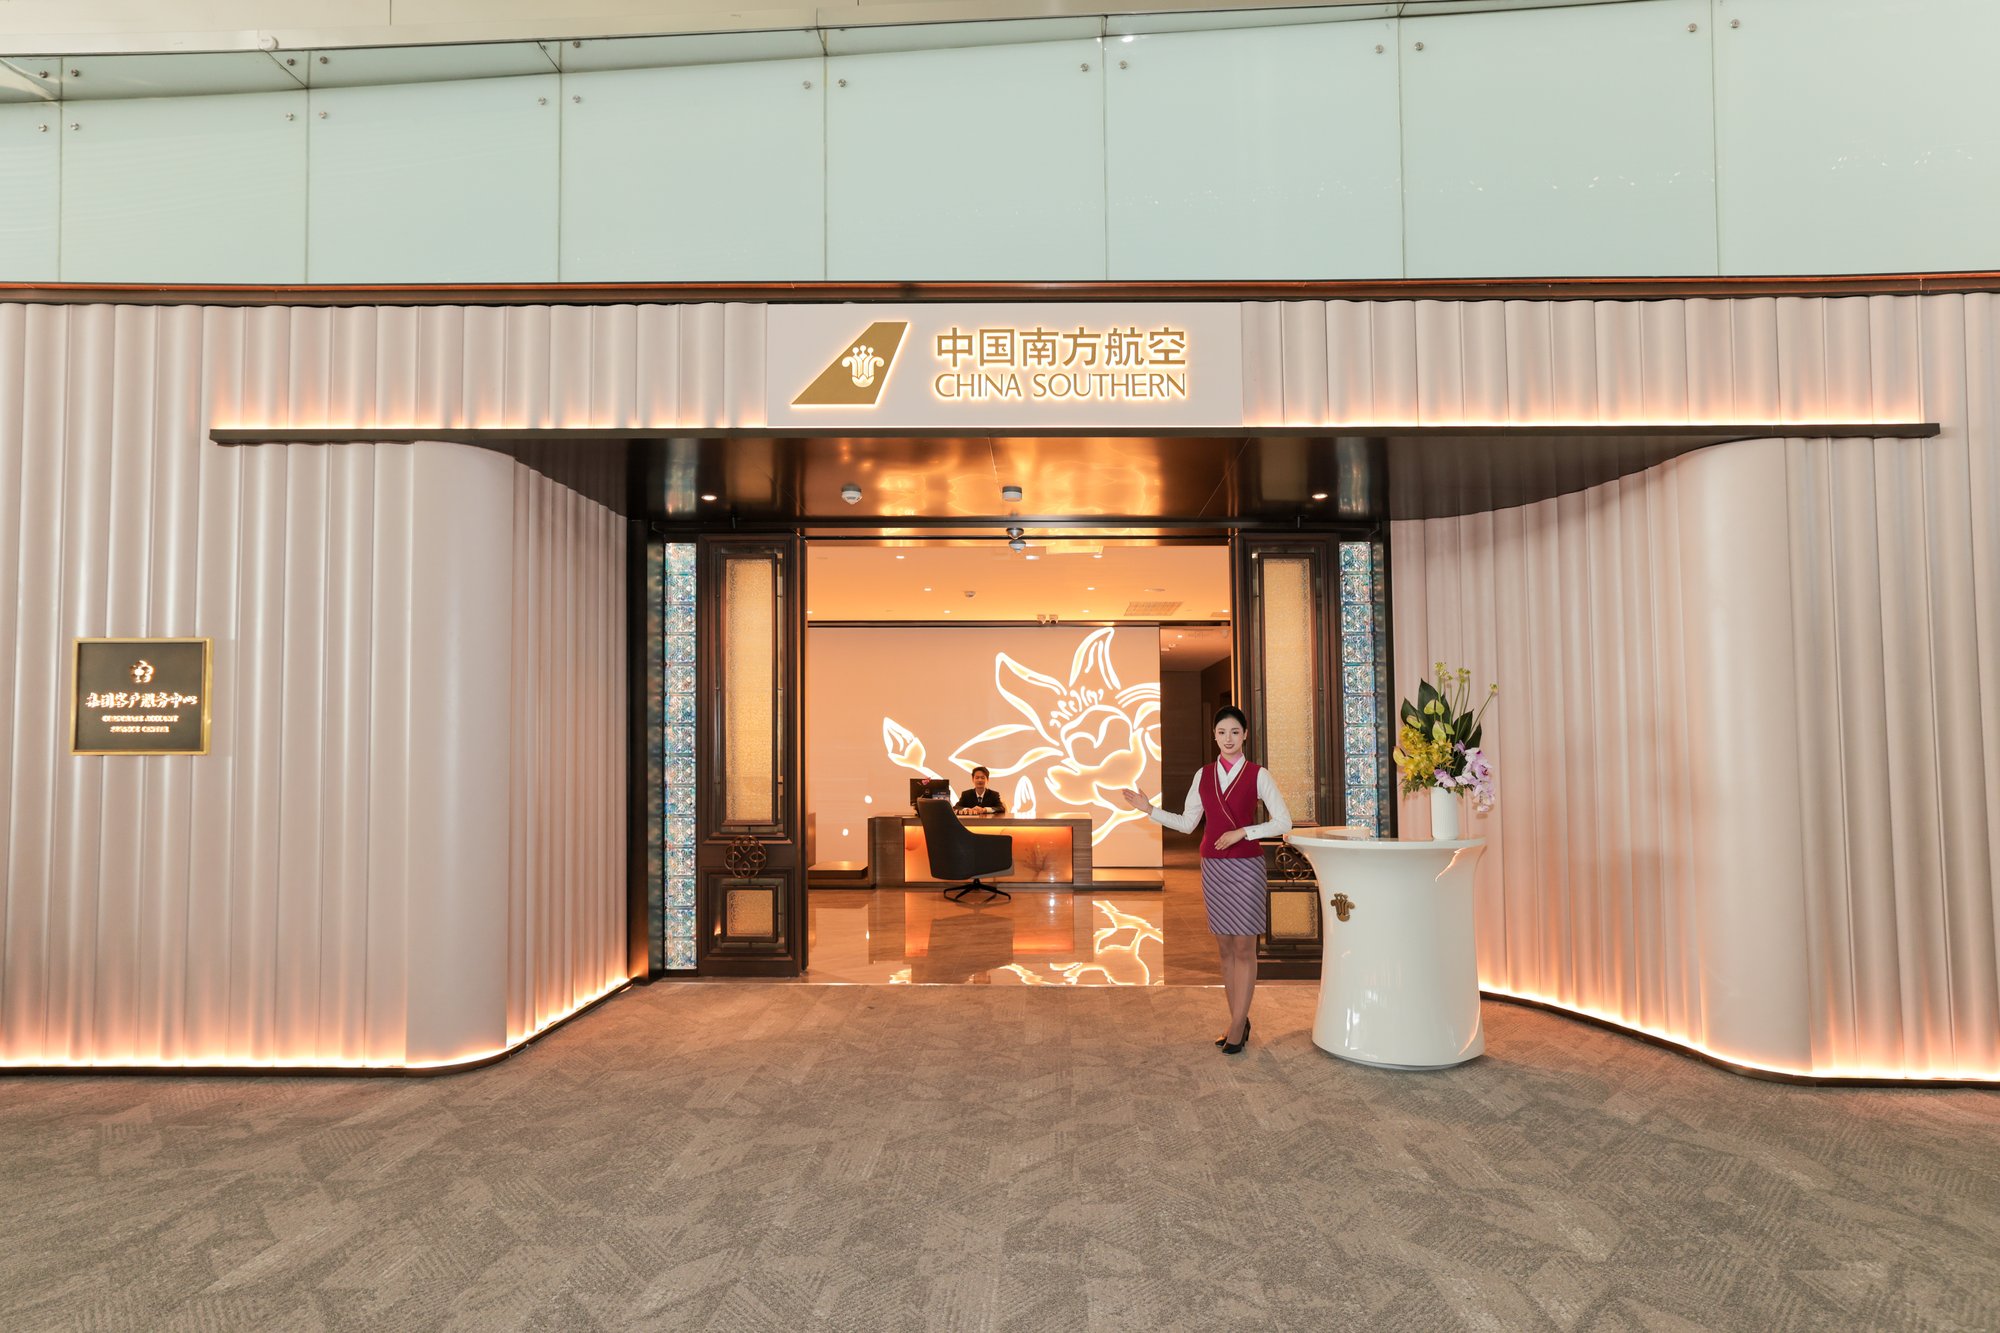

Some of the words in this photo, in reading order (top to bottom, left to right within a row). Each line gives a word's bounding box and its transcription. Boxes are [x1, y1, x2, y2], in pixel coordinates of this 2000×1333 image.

[937, 327, 1186, 367] 中国南方航空
[935, 373, 1021, 397] CHINA
[1033, 373, 1185, 397] SOUTHERN
